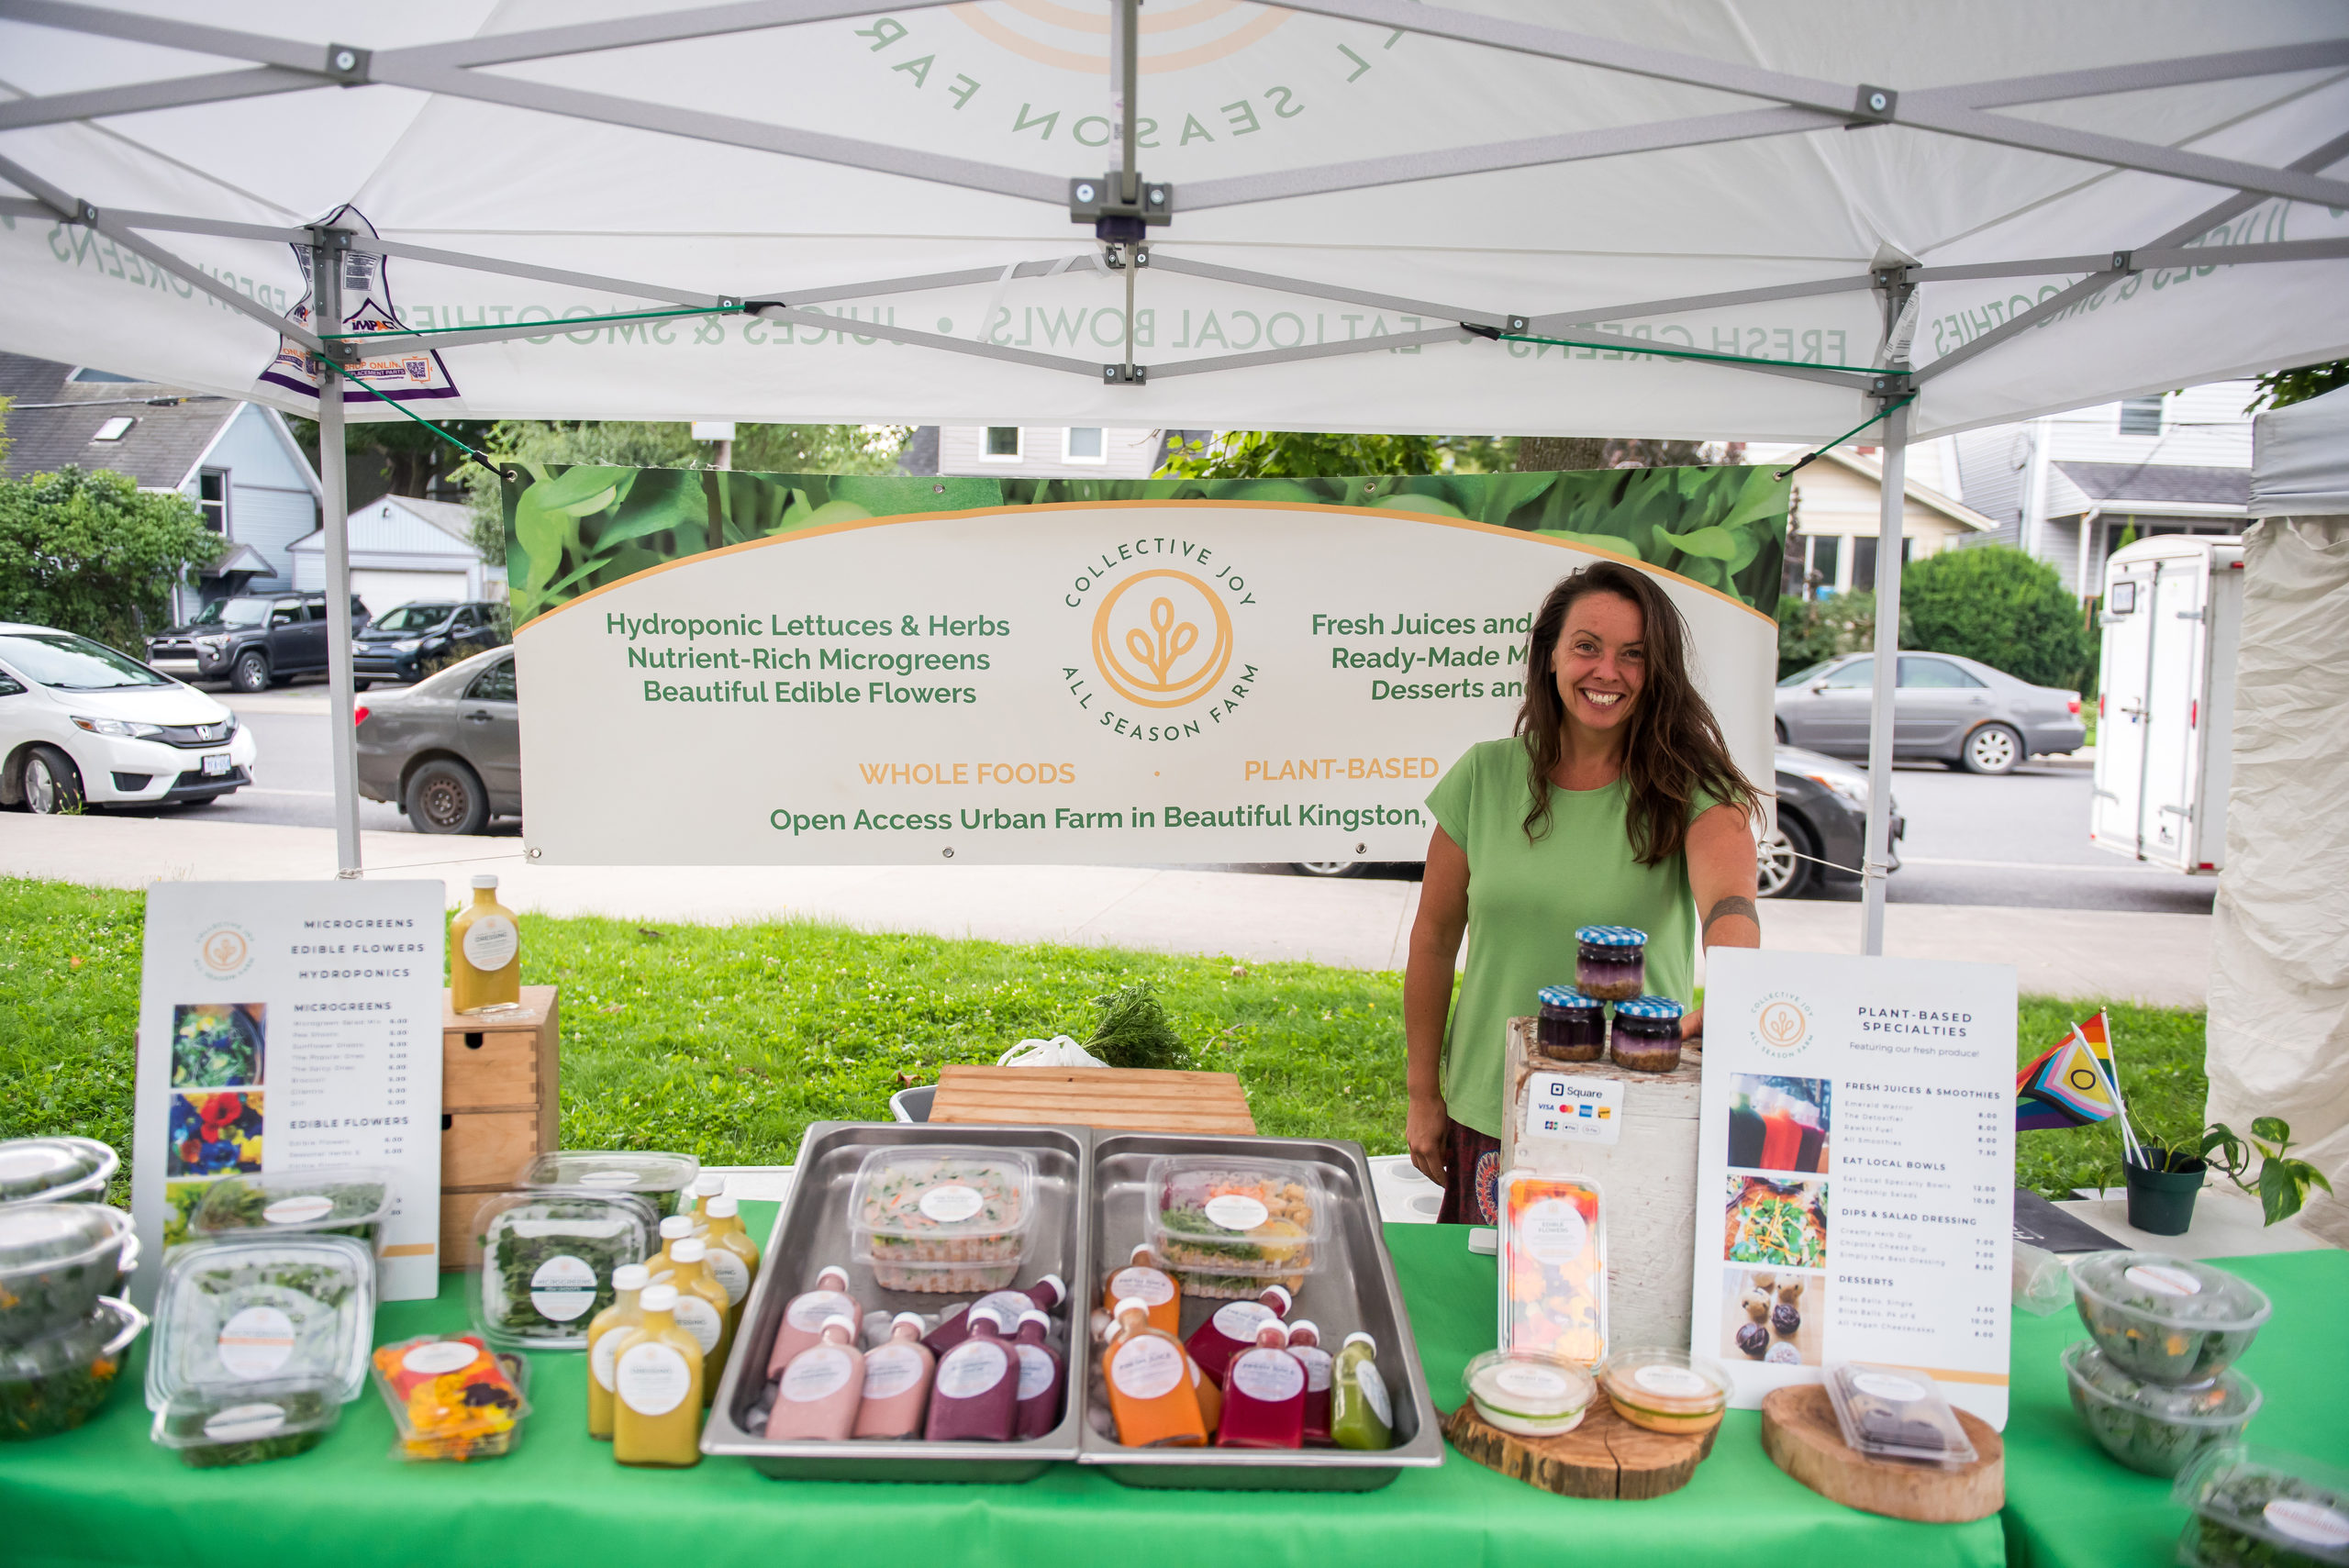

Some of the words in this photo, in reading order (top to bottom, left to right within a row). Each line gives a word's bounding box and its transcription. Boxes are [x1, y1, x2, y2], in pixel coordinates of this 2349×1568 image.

[370, 361, 401, 370] ONLIN
[1065, 538, 1212, 607] COLLECTIVE
[1215, 566, 1256, 606] JOY
[606, 612, 763, 640] Hydroponic
[771, 613, 893, 638] Lettuces
[900, 615, 920, 638] &
[928, 615, 1010, 638] Herbs
[1311, 613, 1385, 637] Fresh
[1392, 613, 1476, 637] Juices
[1483, 612, 1532, 634] and
[628, 646, 812, 671] Nutrient-Rich
[819, 647, 991, 676] Microgreens
[1331, 646, 1500, 674] Ready-Made
[643, 679, 768, 704] Beautiful
[774, 681, 862, 705] Edible
[869, 681, 976, 705] Flowers
[1370, 676, 1485, 702] Desserts
[1062, 667, 1093, 710] ALL
[1099, 711, 1201, 741] SEASON
[1209, 663, 1259, 724] FARM
[859, 762, 969, 784] WHOLE
[977, 762, 1076, 784] FOODS
[1244, 757, 1439, 783] PLANT-BASED
[769, 807, 847, 836] Open
[853, 806, 953, 831] Access
[960, 806, 1049, 830] Urban
[1053, 806, 1125, 831] Farm
[1130, 806, 1156, 830] in
[1163, 802, 1292, 829] Beautiful
[1298, 802, 1428, 835] Kingston,
[304, 919, 414, 929] MICROGREENS
[291, 945, 346, 954] EDIBLE
[352, 944, 425, 953] FLOWERS
[299, 969, 410, 979] HYDROPONICS
[294, 1002, 392, 1012] MICROGREENS
[1858, 1006, 1972, 1023] PLANT-BASED
[1863, 1021, 1967, 1037] SPECIALTIES
[1850, 1041, 1893, 1053] Featuring
[1913, 1046, 1936, 1055] fresh
[1567, 1086, 1602, 1098] Square
[1845, 1082, 1880, 1091] FRESH
[1884, 1084, 1921, 1094] JUICES
[1936, 1088, 2000, 1099] SMOOTHIES
[290, 1119, 338, 1129] EDIBLE
[344, 1117, 408, 1127] FLOWERS
[1867, 1158, 1902, 1168] LOCAL
[1907, 1162, 1945, 1171] BOWLS
[1842, 1208, 1866, 1218] DIPS
[1882, 1212, 1918, 1221] SALAD
[1922, 1215, 1976, 1226] DRESSING
[1839, 1275, 1894, 1286] DESSERTS
